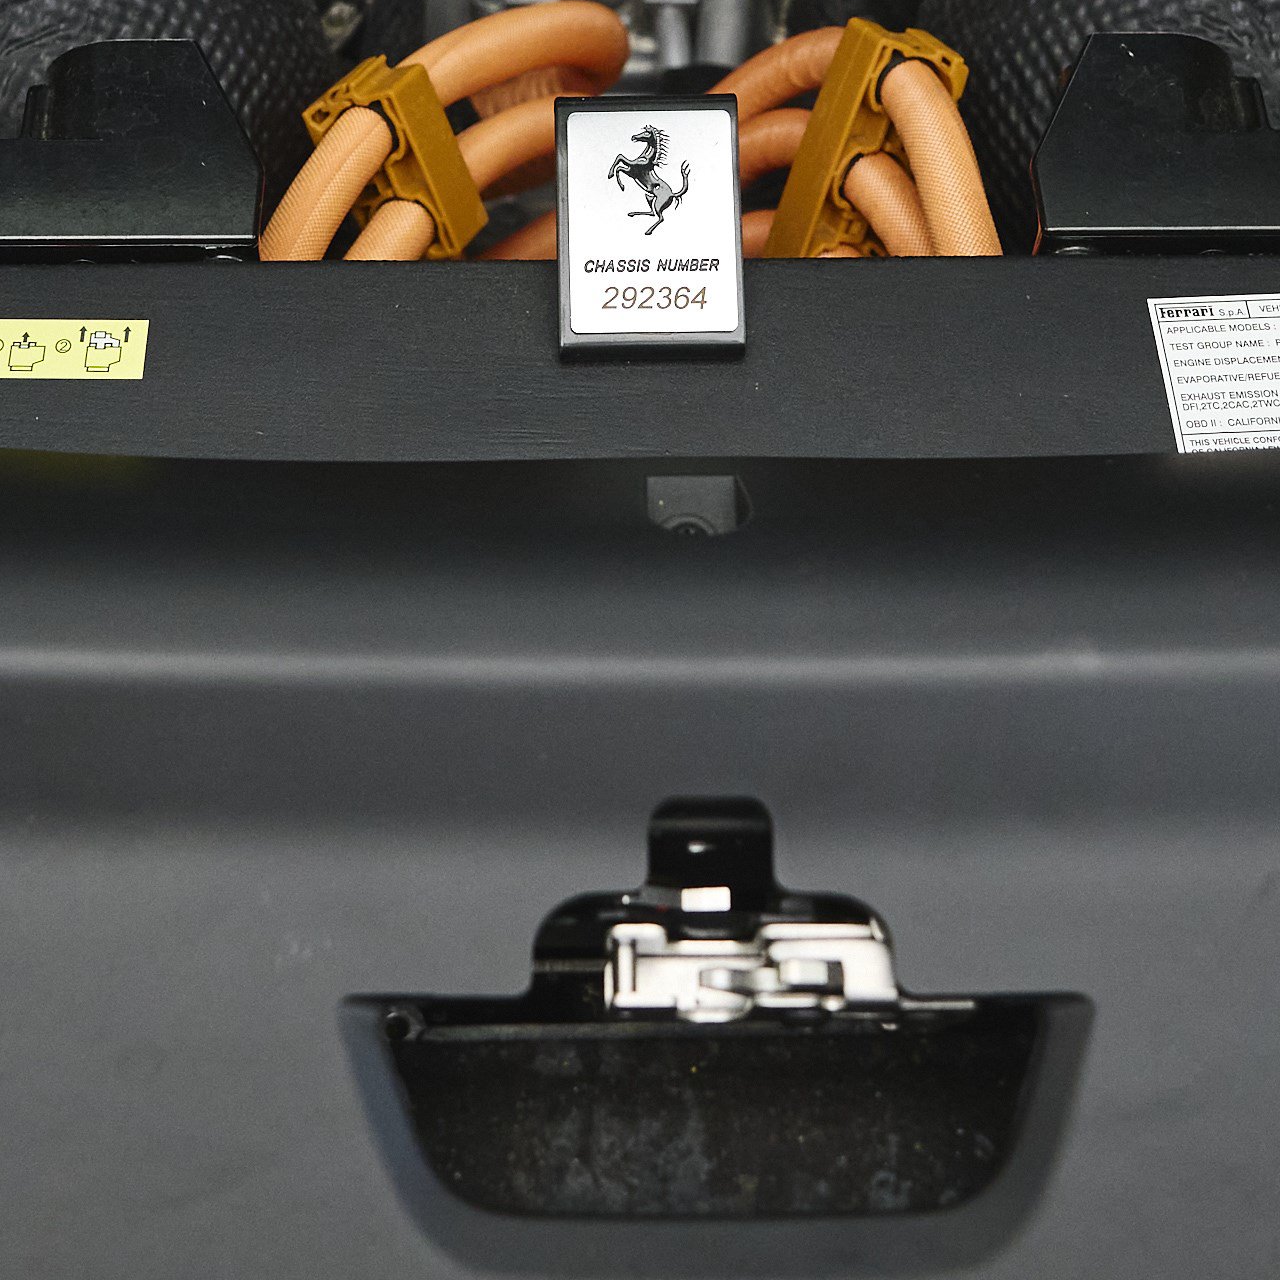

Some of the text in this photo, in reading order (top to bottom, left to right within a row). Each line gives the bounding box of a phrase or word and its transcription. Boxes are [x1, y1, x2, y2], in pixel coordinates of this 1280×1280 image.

[584, 258, 720, 273] CHASSIS NUMBER
[602, 286, 708, 310] 292364
[1159, 306, 1215, 319] Ferrari
[1166, 324, 1226, 334] APPLICABLE
[1169, 342, 1194, 351] TEST
[1196, 340, 1232, 350] GROUP
[1173, 358, 1212, 368] ENGINE
[1180, 392, 1226, 402] EXHAUST
[1229, 389, 1279, 400] EMISSION
[1186, 420, 1208, 428] OBD
[1190, 438, 1210, 446] THIS
[1212, 437, 1250, 446] VEHICLE
